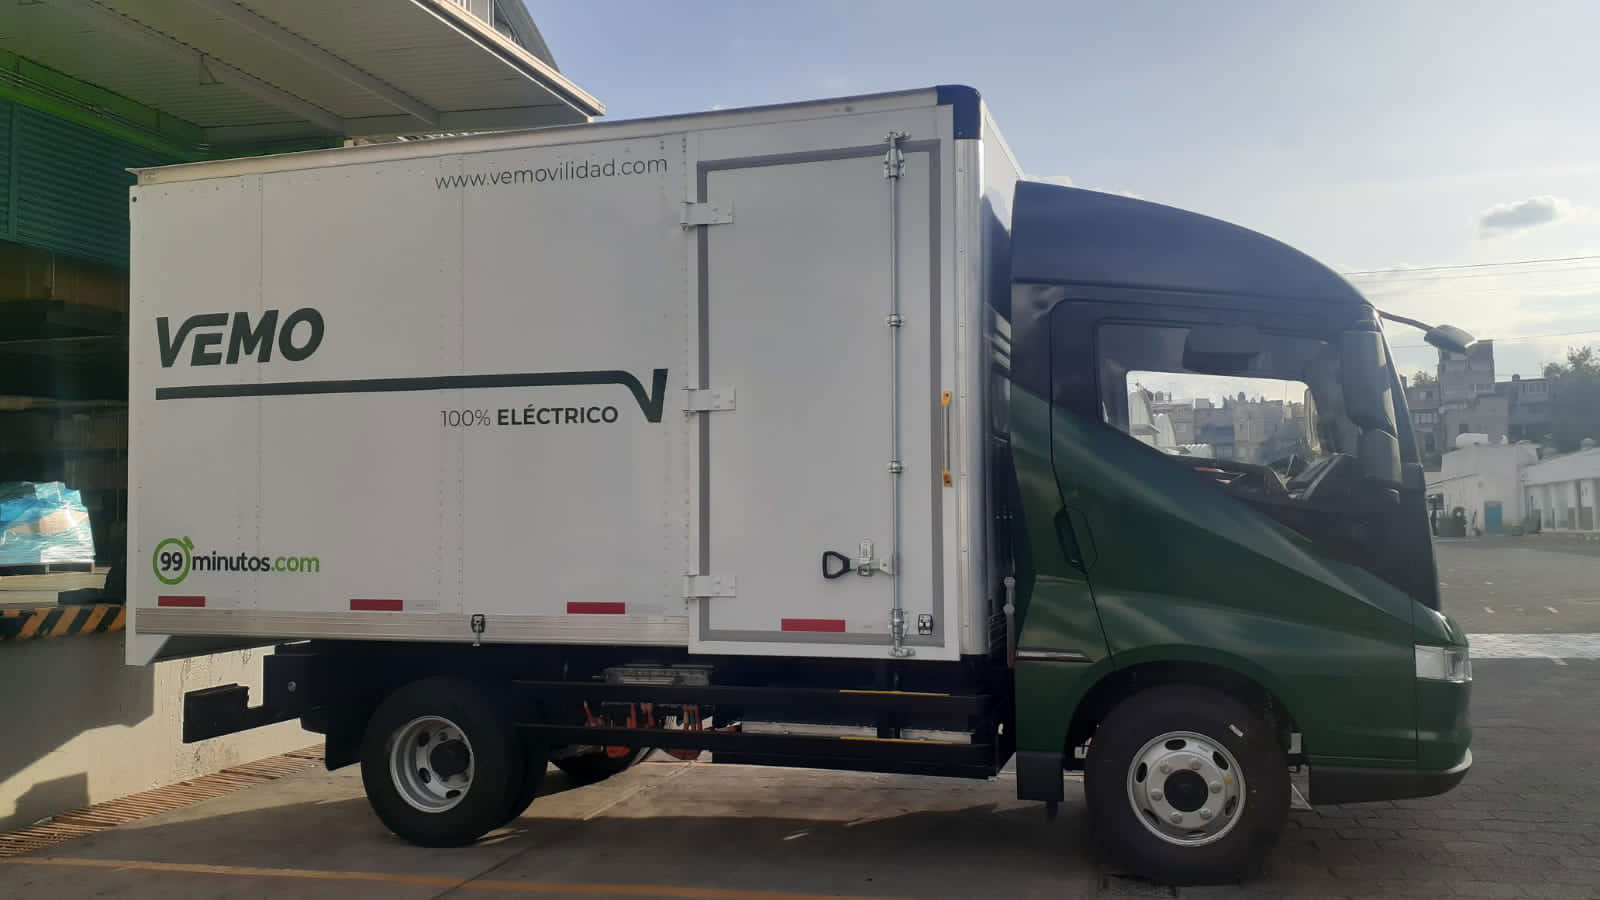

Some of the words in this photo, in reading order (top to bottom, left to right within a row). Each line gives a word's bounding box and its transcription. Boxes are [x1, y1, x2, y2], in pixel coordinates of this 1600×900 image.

[435, 157, 668, 190] www.vemovilidad.com
[155, 307, 325, 368] VEMO
[440, 409, 491, 428] 100%
[496, 404, 619, 426] ELÉCTRICO
